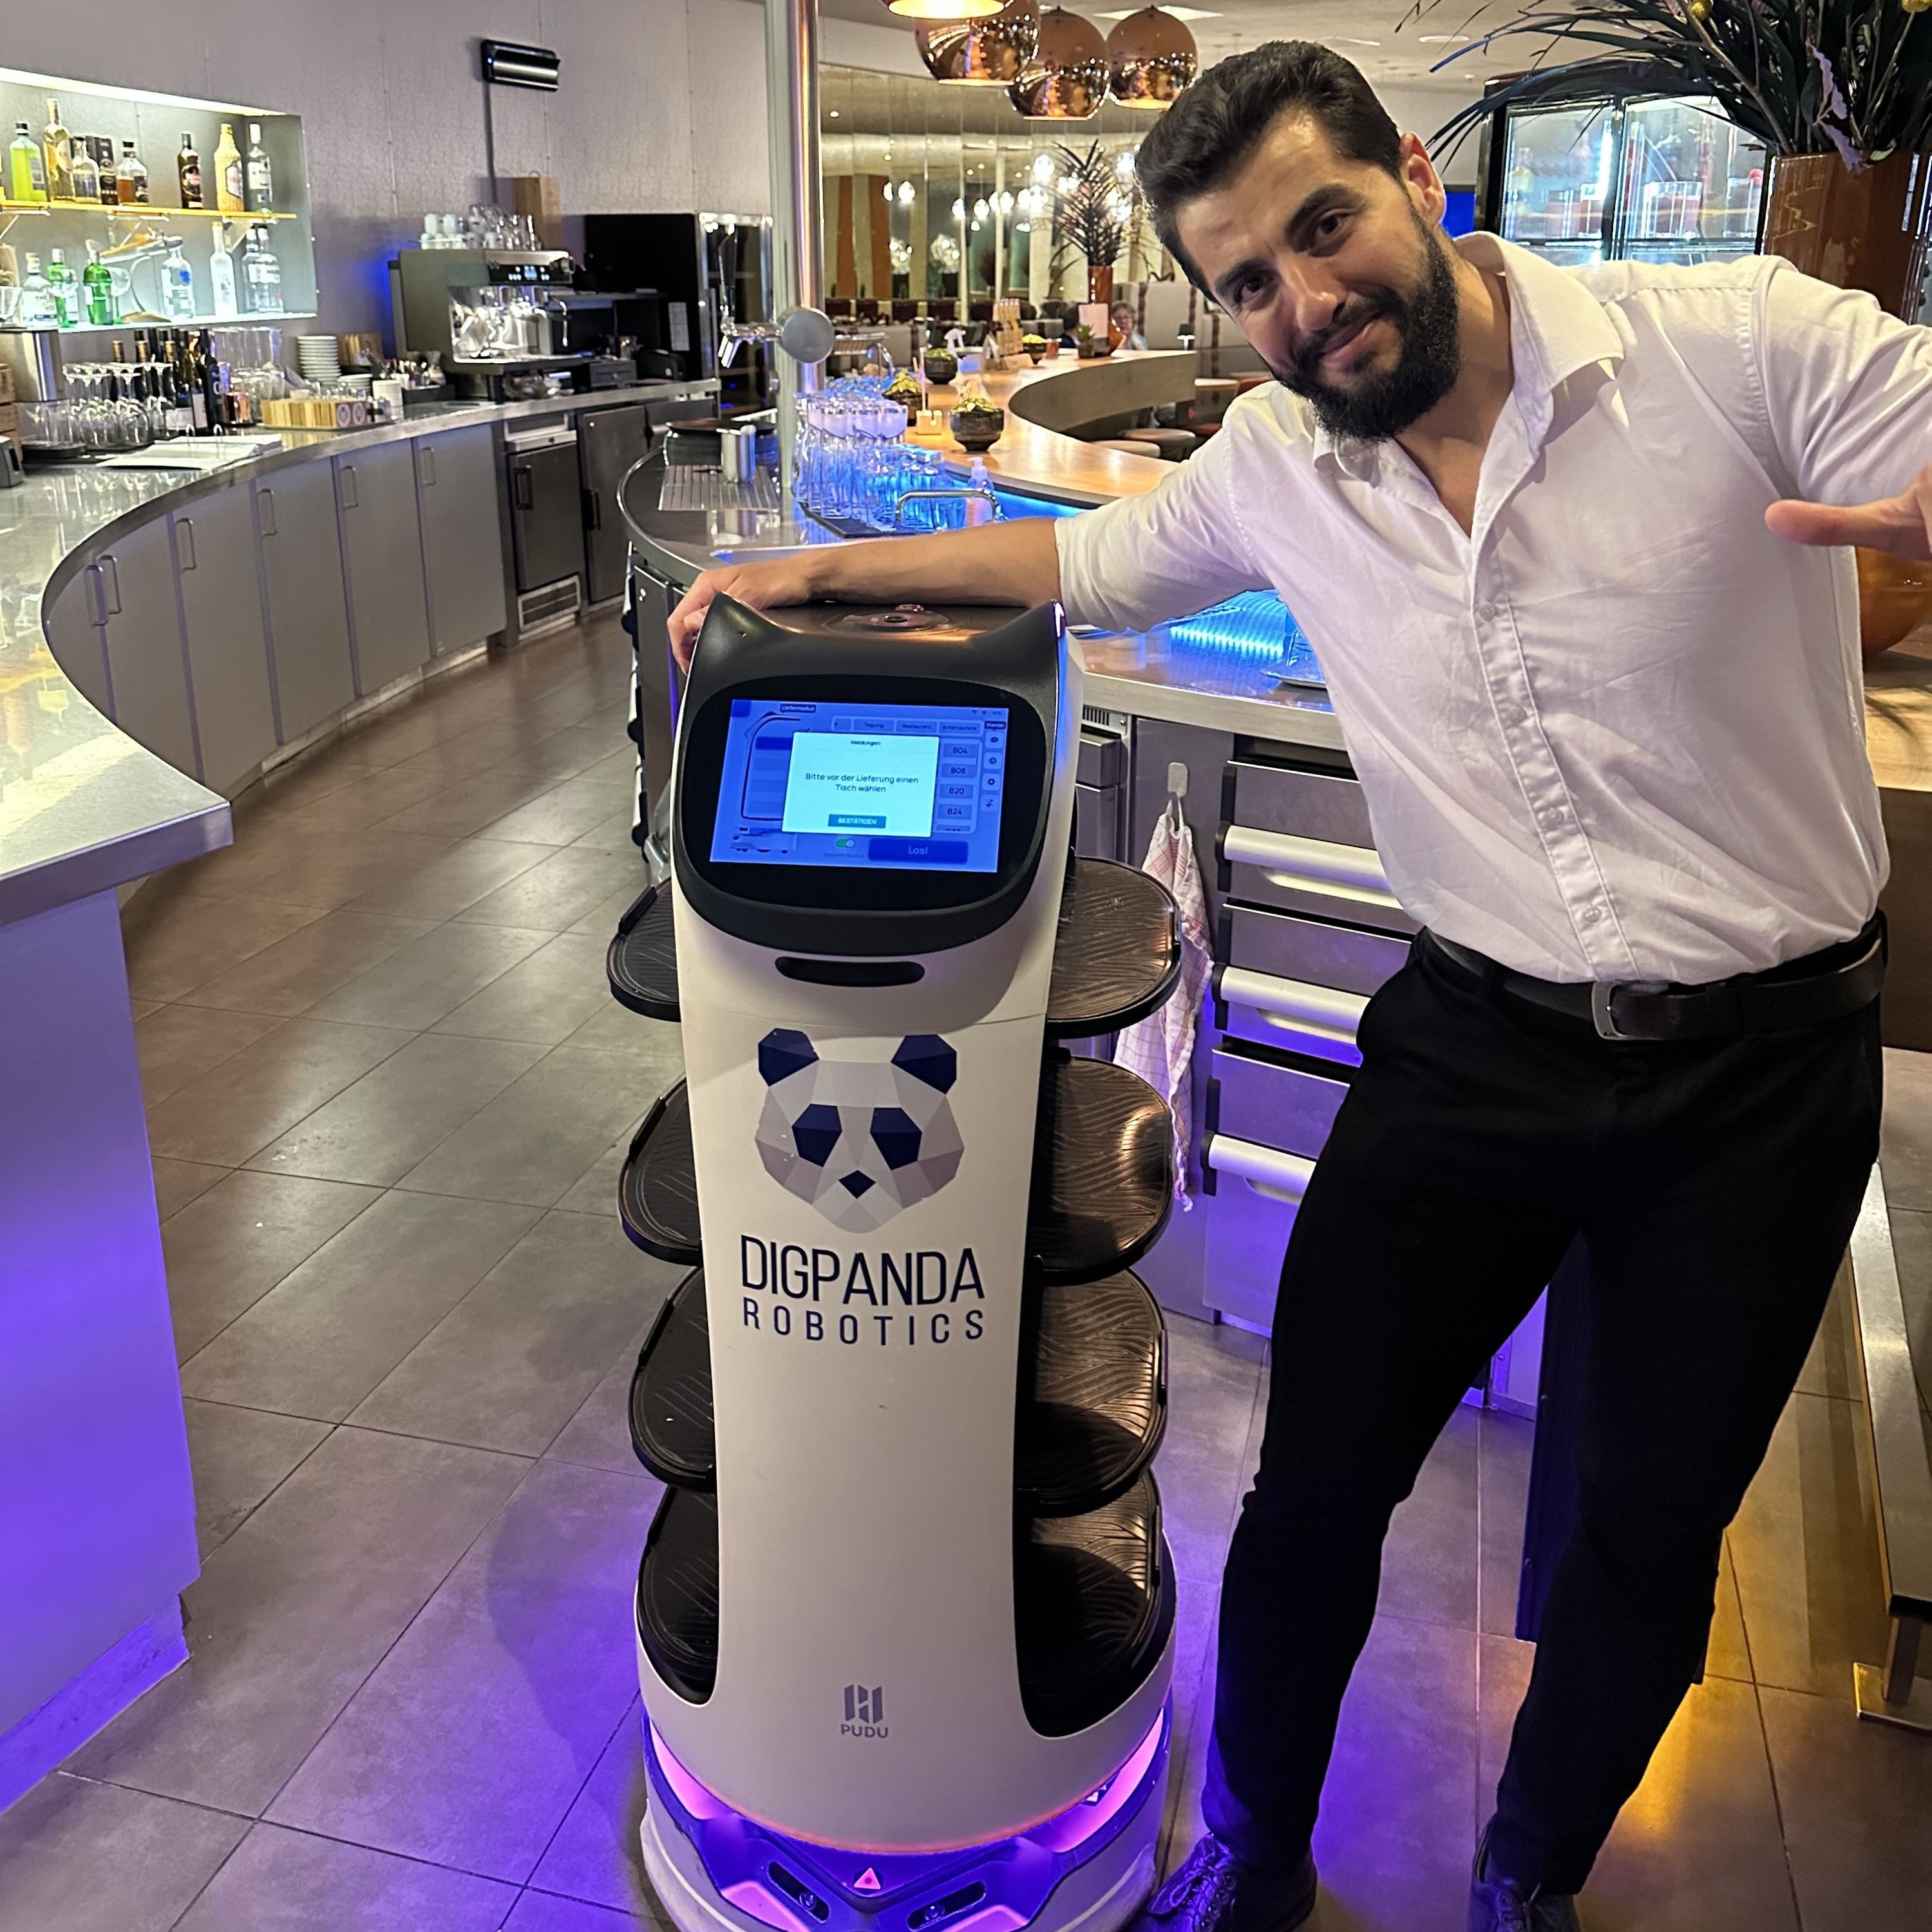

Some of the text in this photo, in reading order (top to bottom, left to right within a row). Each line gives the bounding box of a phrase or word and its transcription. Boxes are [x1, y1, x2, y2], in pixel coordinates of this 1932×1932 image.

[857, 775, 895, 784] Lieferung
[741, 1234, 985, 1306] DIGPANDA
[743, 1296, 983, 1346] ROBOTICS
[841, 1723, 888, 1738] PUDU
